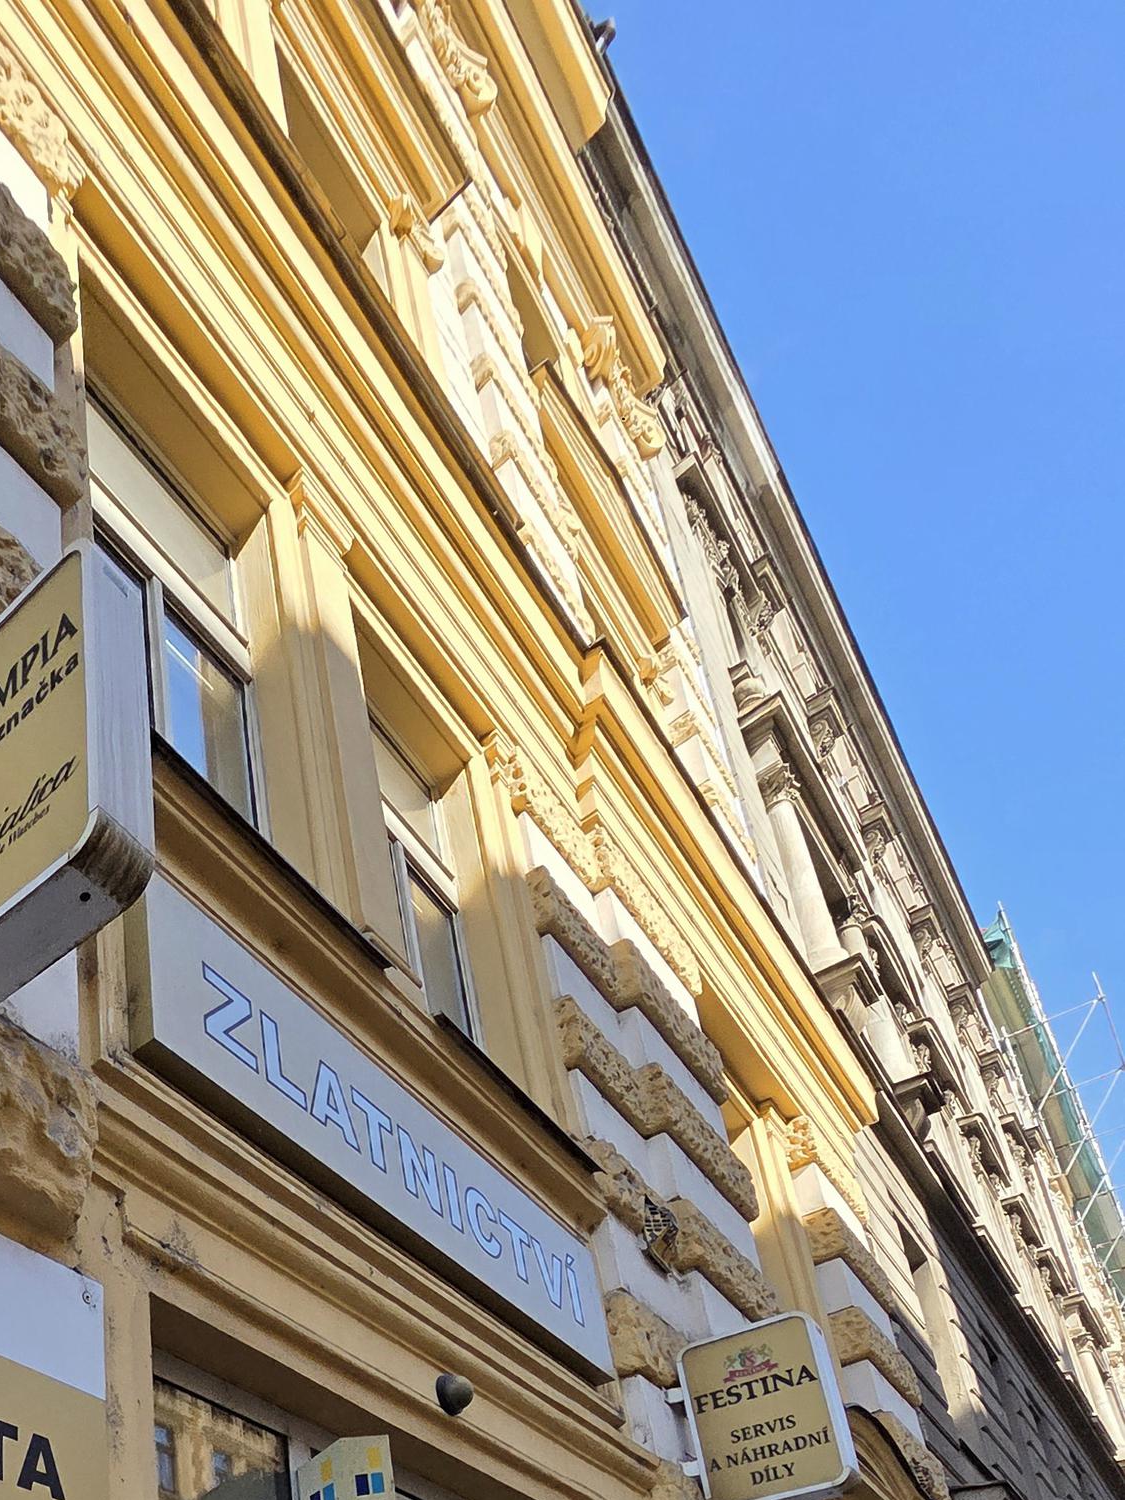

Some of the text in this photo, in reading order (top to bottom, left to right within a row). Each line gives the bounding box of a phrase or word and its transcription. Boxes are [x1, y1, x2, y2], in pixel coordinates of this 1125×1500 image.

[201, 960, 586, 1329] ZLATNICTVÍ
[693, 1364, 818, 1415] FESTINA
[709, 1426, 831, 1473] A NÁHRADNÍ
[730, 1414, 797, 1444] SERVIS
[750, 1461, 796, 1486] DÍLY
